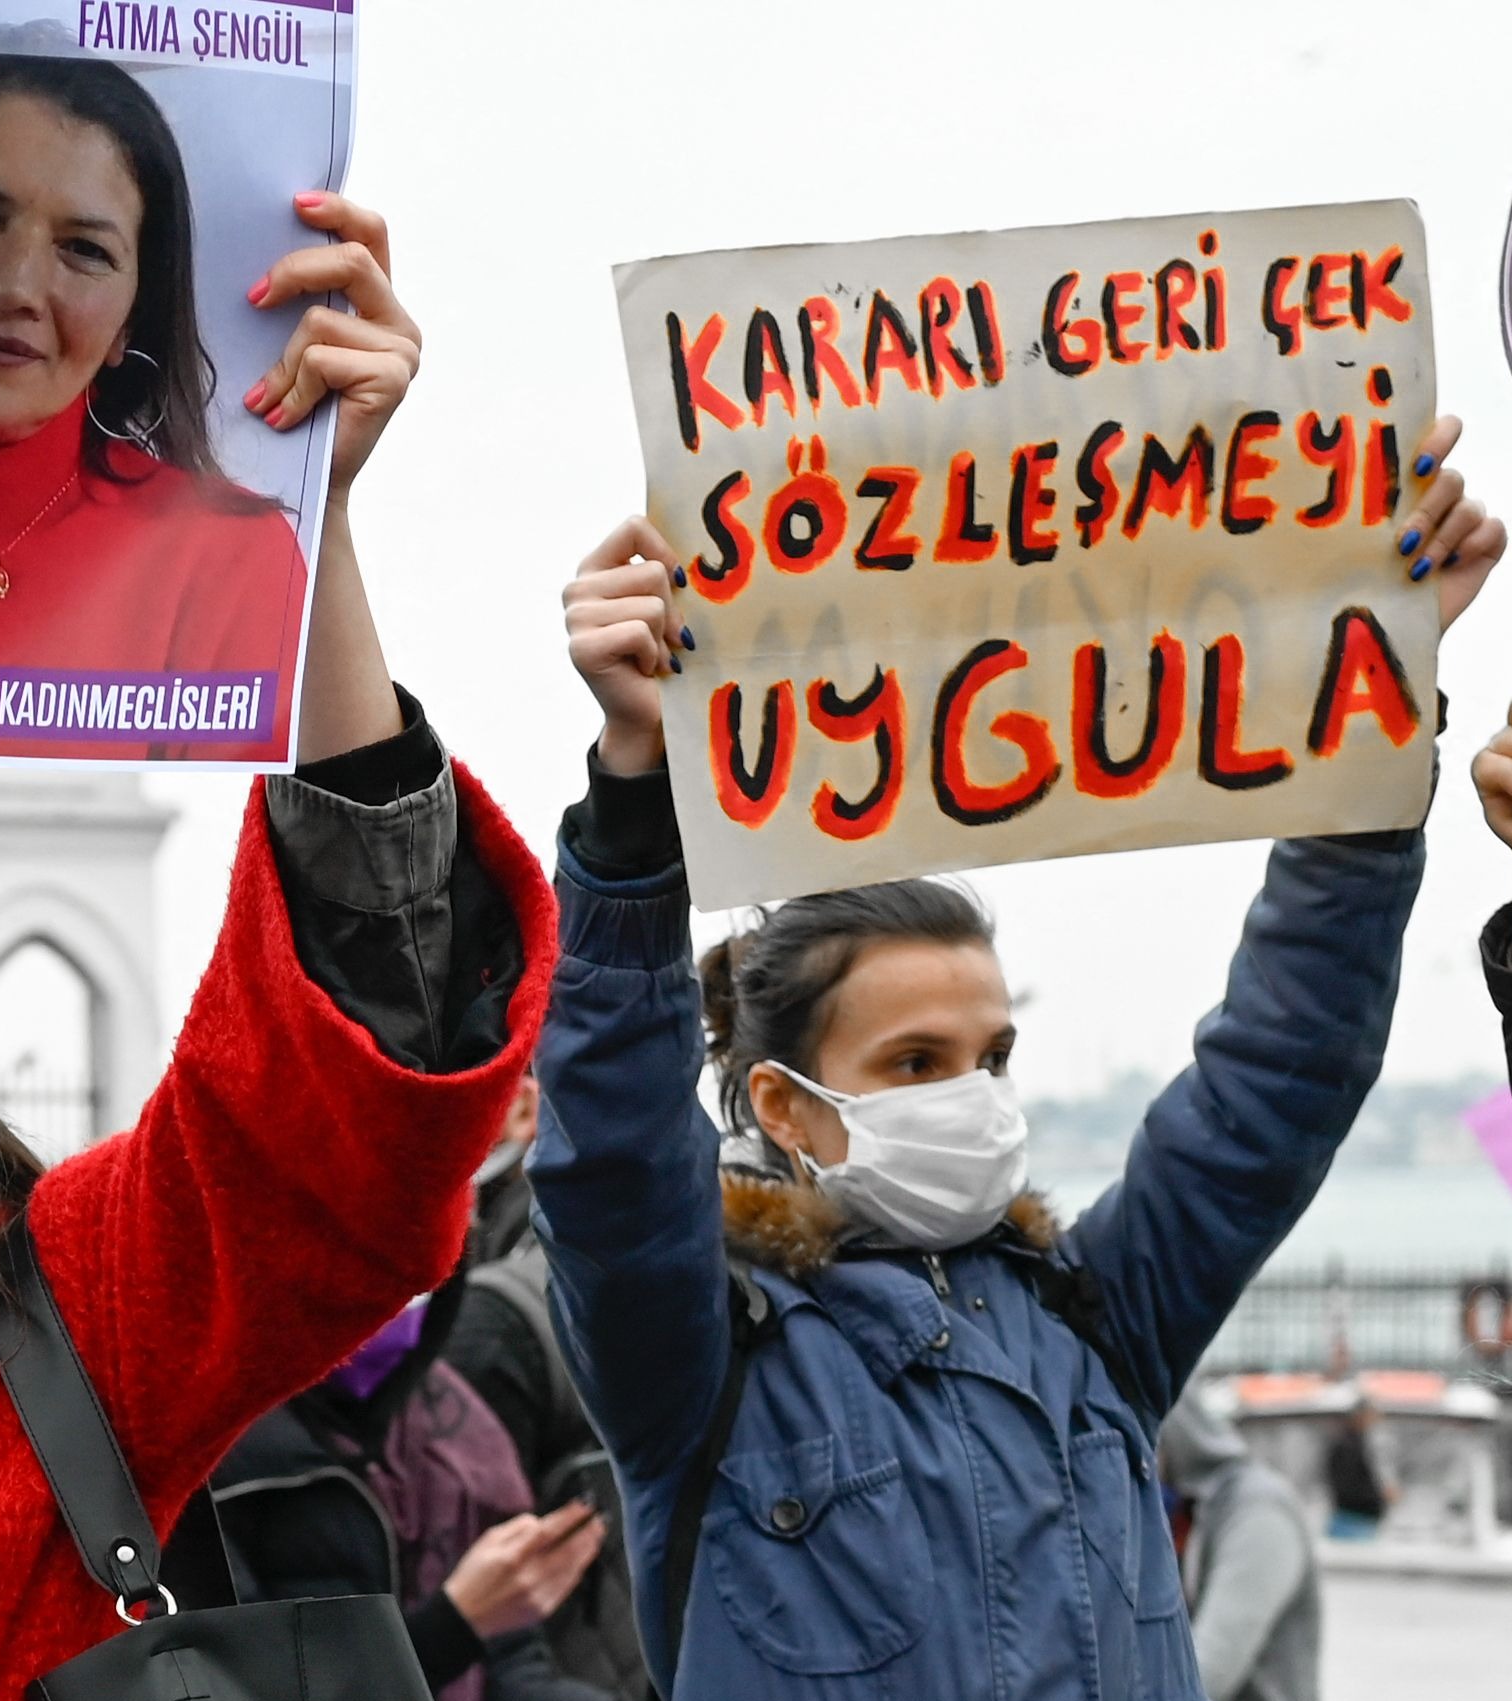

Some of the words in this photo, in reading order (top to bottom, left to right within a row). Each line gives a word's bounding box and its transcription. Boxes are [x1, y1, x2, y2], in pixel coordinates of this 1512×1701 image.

[78, 0, 181, 54] FATMA
[192, 10, 309, 67] ŞENGÜL
[665, 276, 1006, 453] KARARI
[1042, 229, 1230, 378] GERİ
[1262, 245, 1414, 357] ÇEK
[687, 366, 1402, 605] SÖZLEŞMEYİ
[708, 606, 1423, 842] UYGULA
